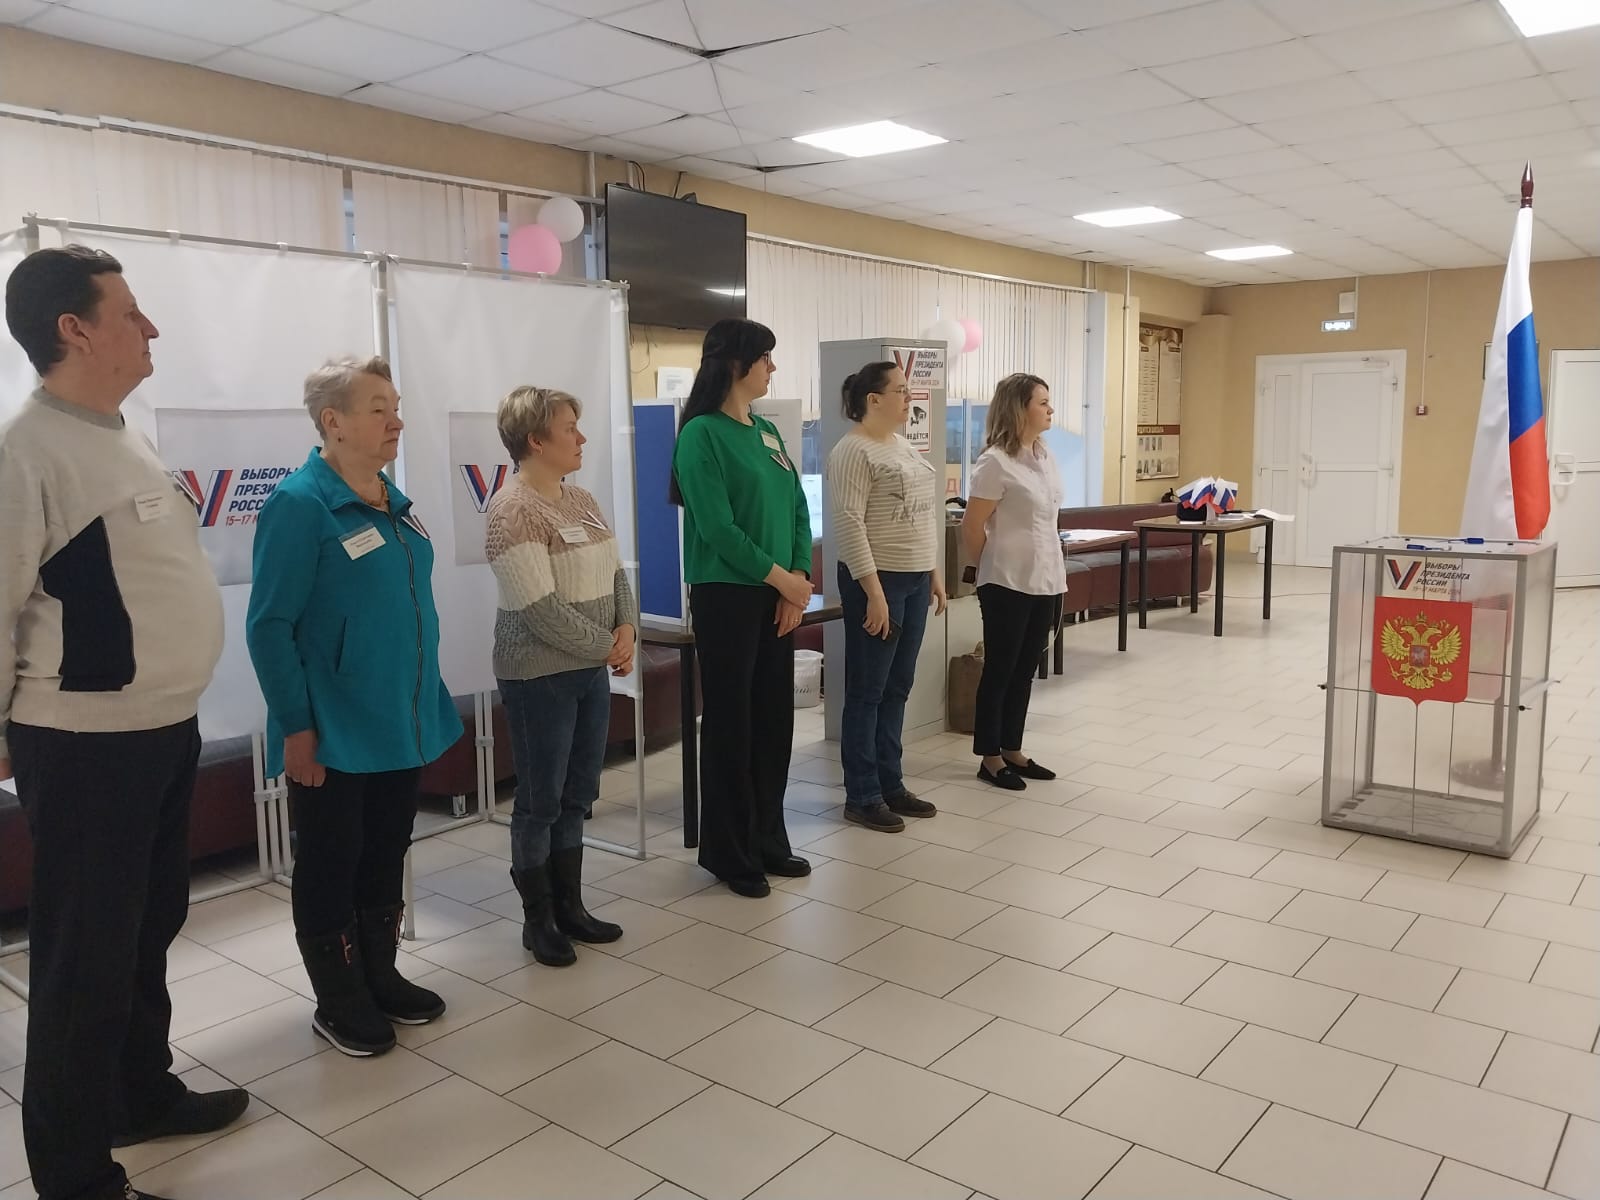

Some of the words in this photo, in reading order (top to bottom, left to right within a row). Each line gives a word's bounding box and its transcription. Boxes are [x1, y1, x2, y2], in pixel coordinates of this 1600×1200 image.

[917, 351, 937, 359] ВЫБОРЫ
[915, 361, 944, 369] ПРЕЗИДЕНТА
[912, 370, 932, 378] РОССИИ
[1425, 562, 1461, 571] ВЫБОРЫ
[1420, 570, 1471, 581] ПРЕЗИДЕНТА
[1415, 578, 1448, 587] РОССИИ
